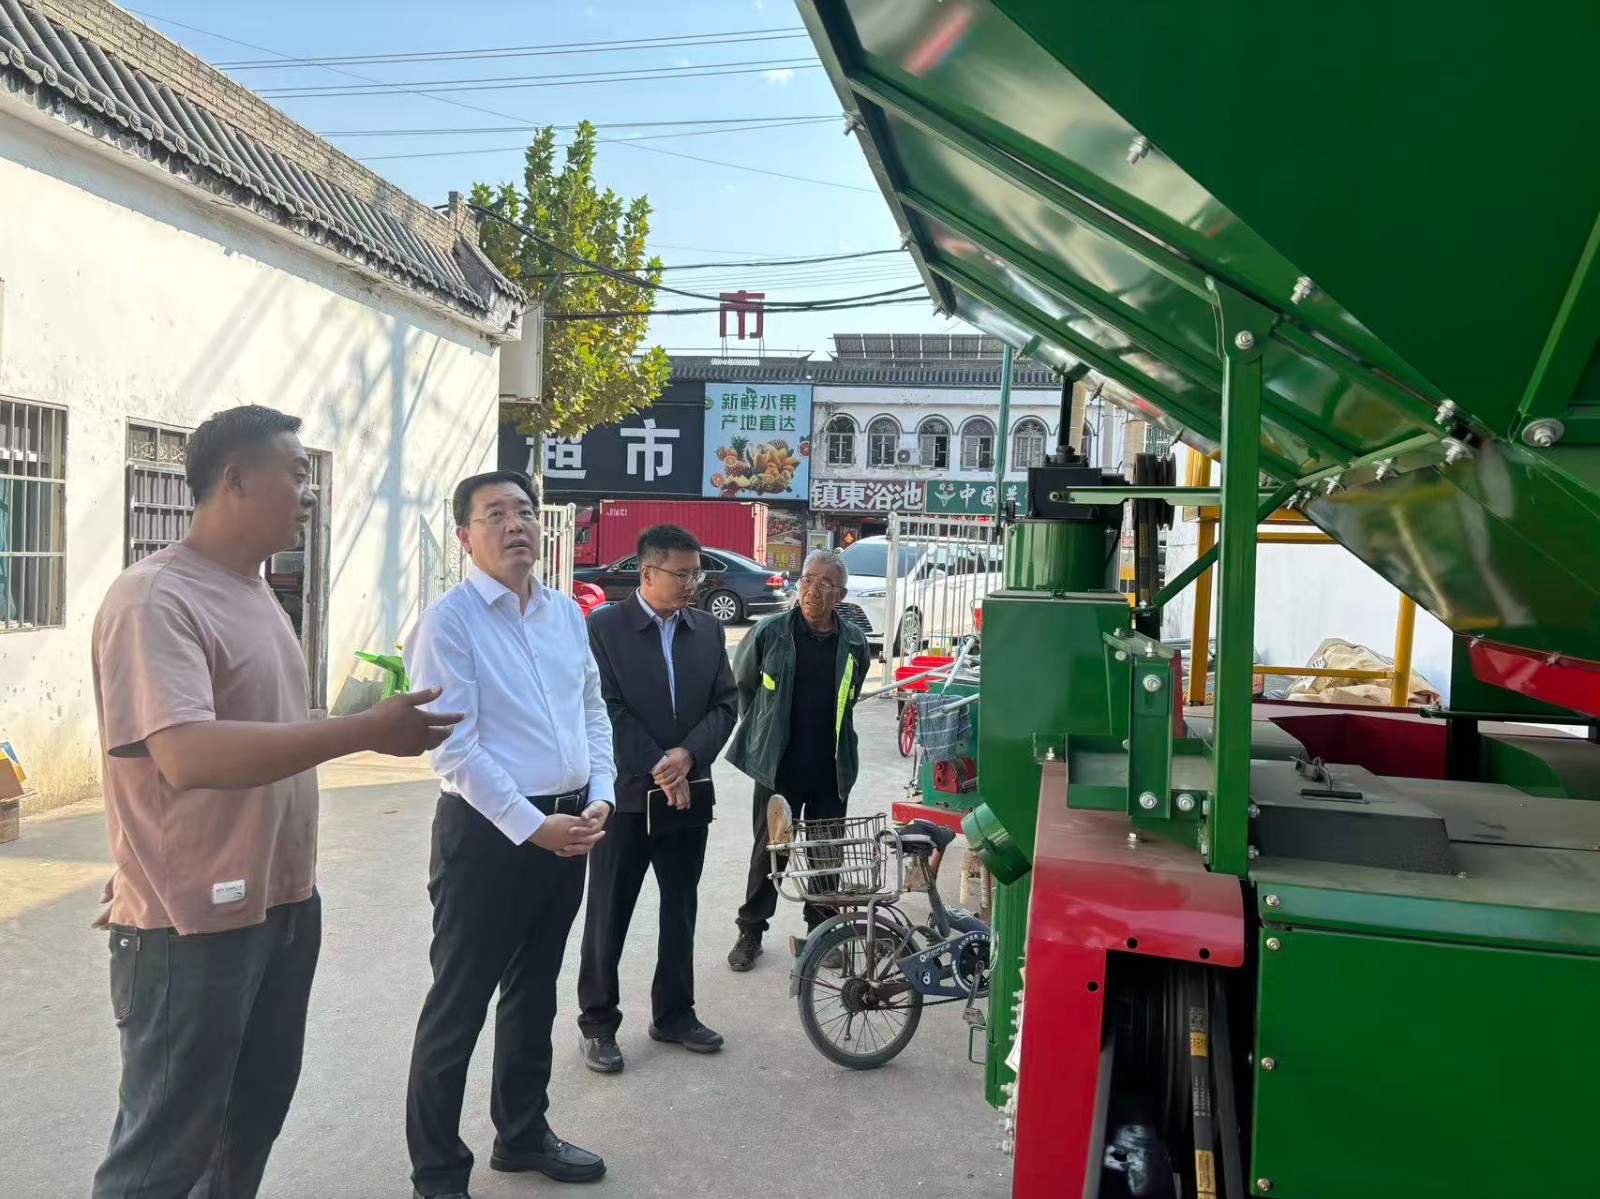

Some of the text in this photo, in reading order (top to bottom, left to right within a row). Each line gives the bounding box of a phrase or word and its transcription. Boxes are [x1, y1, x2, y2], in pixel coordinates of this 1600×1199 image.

[719, 290, 765, 340] 市
[721, 392, 797, 411] 新鲜水果
[720, 414, 796, 432] 产地直达
[526, 418, 680, 482] 超市
[810, 479, 923, 511] 镇東浴池
[959, 483, 1027, 509] 中国兰
